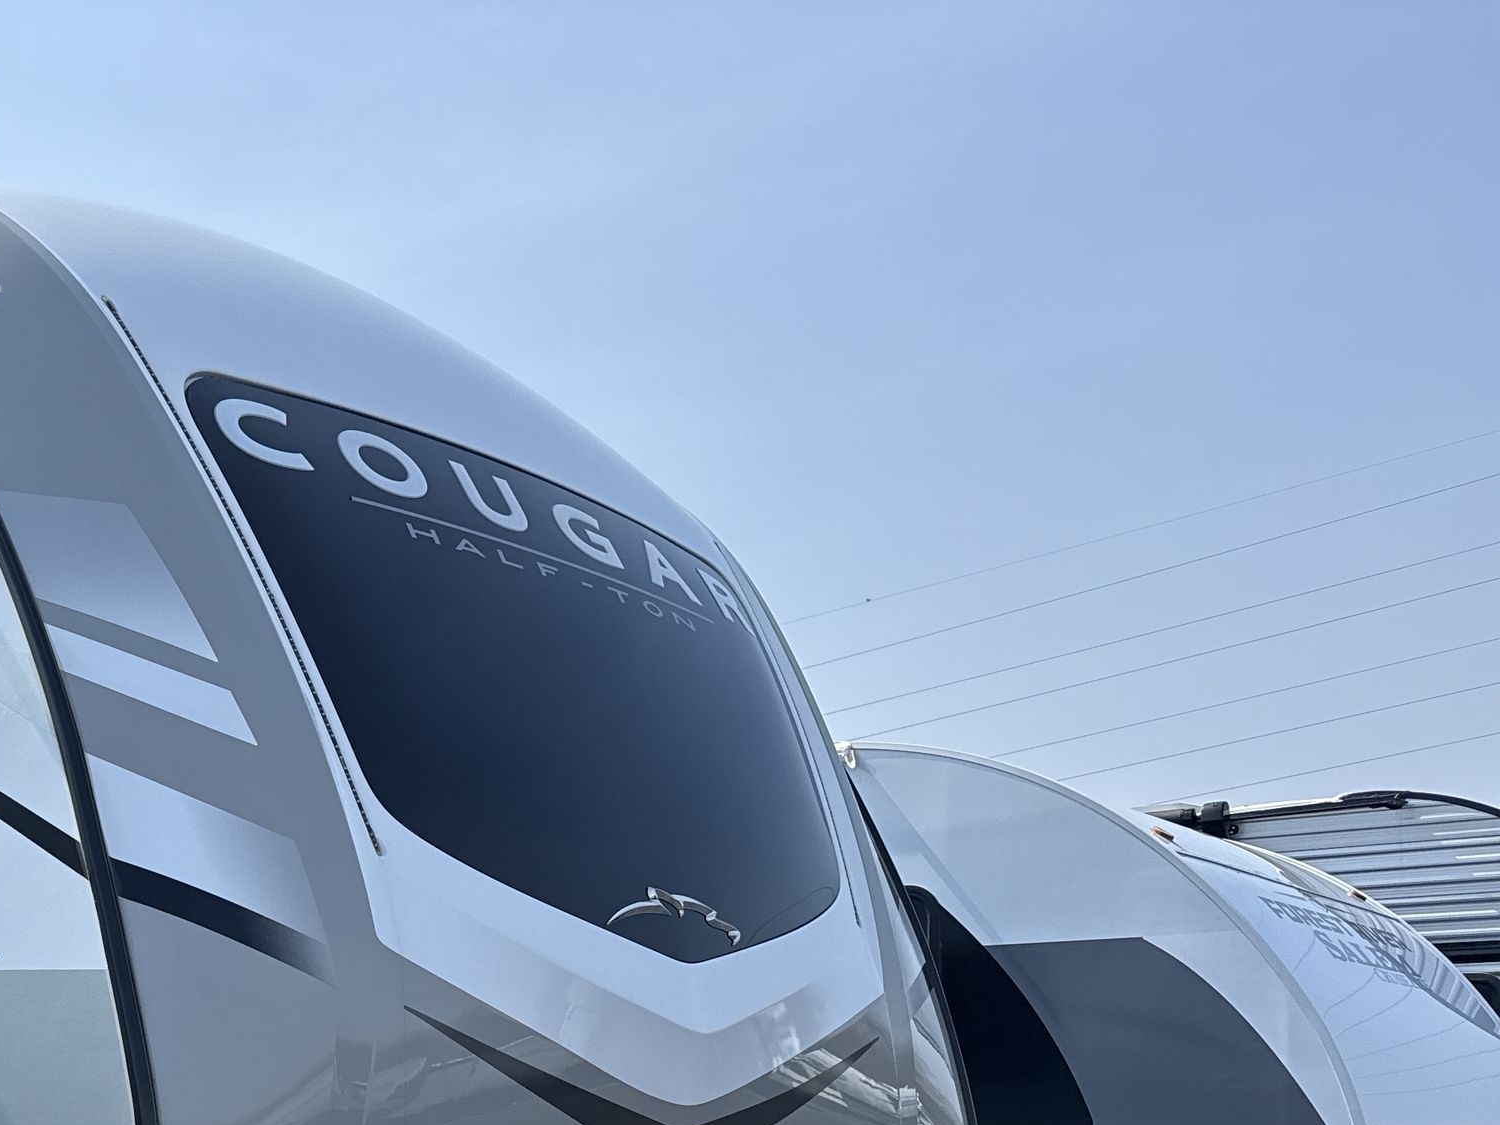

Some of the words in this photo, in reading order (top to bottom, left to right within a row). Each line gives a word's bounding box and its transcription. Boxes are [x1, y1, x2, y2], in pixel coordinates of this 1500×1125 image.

[213, 397, 756, 639] COUGAR
[404, 521, 697, 632] HALF-TON
[1257, 895, 1354, 937] FOREST
[1346, 920, 1414, 953] RIVER
